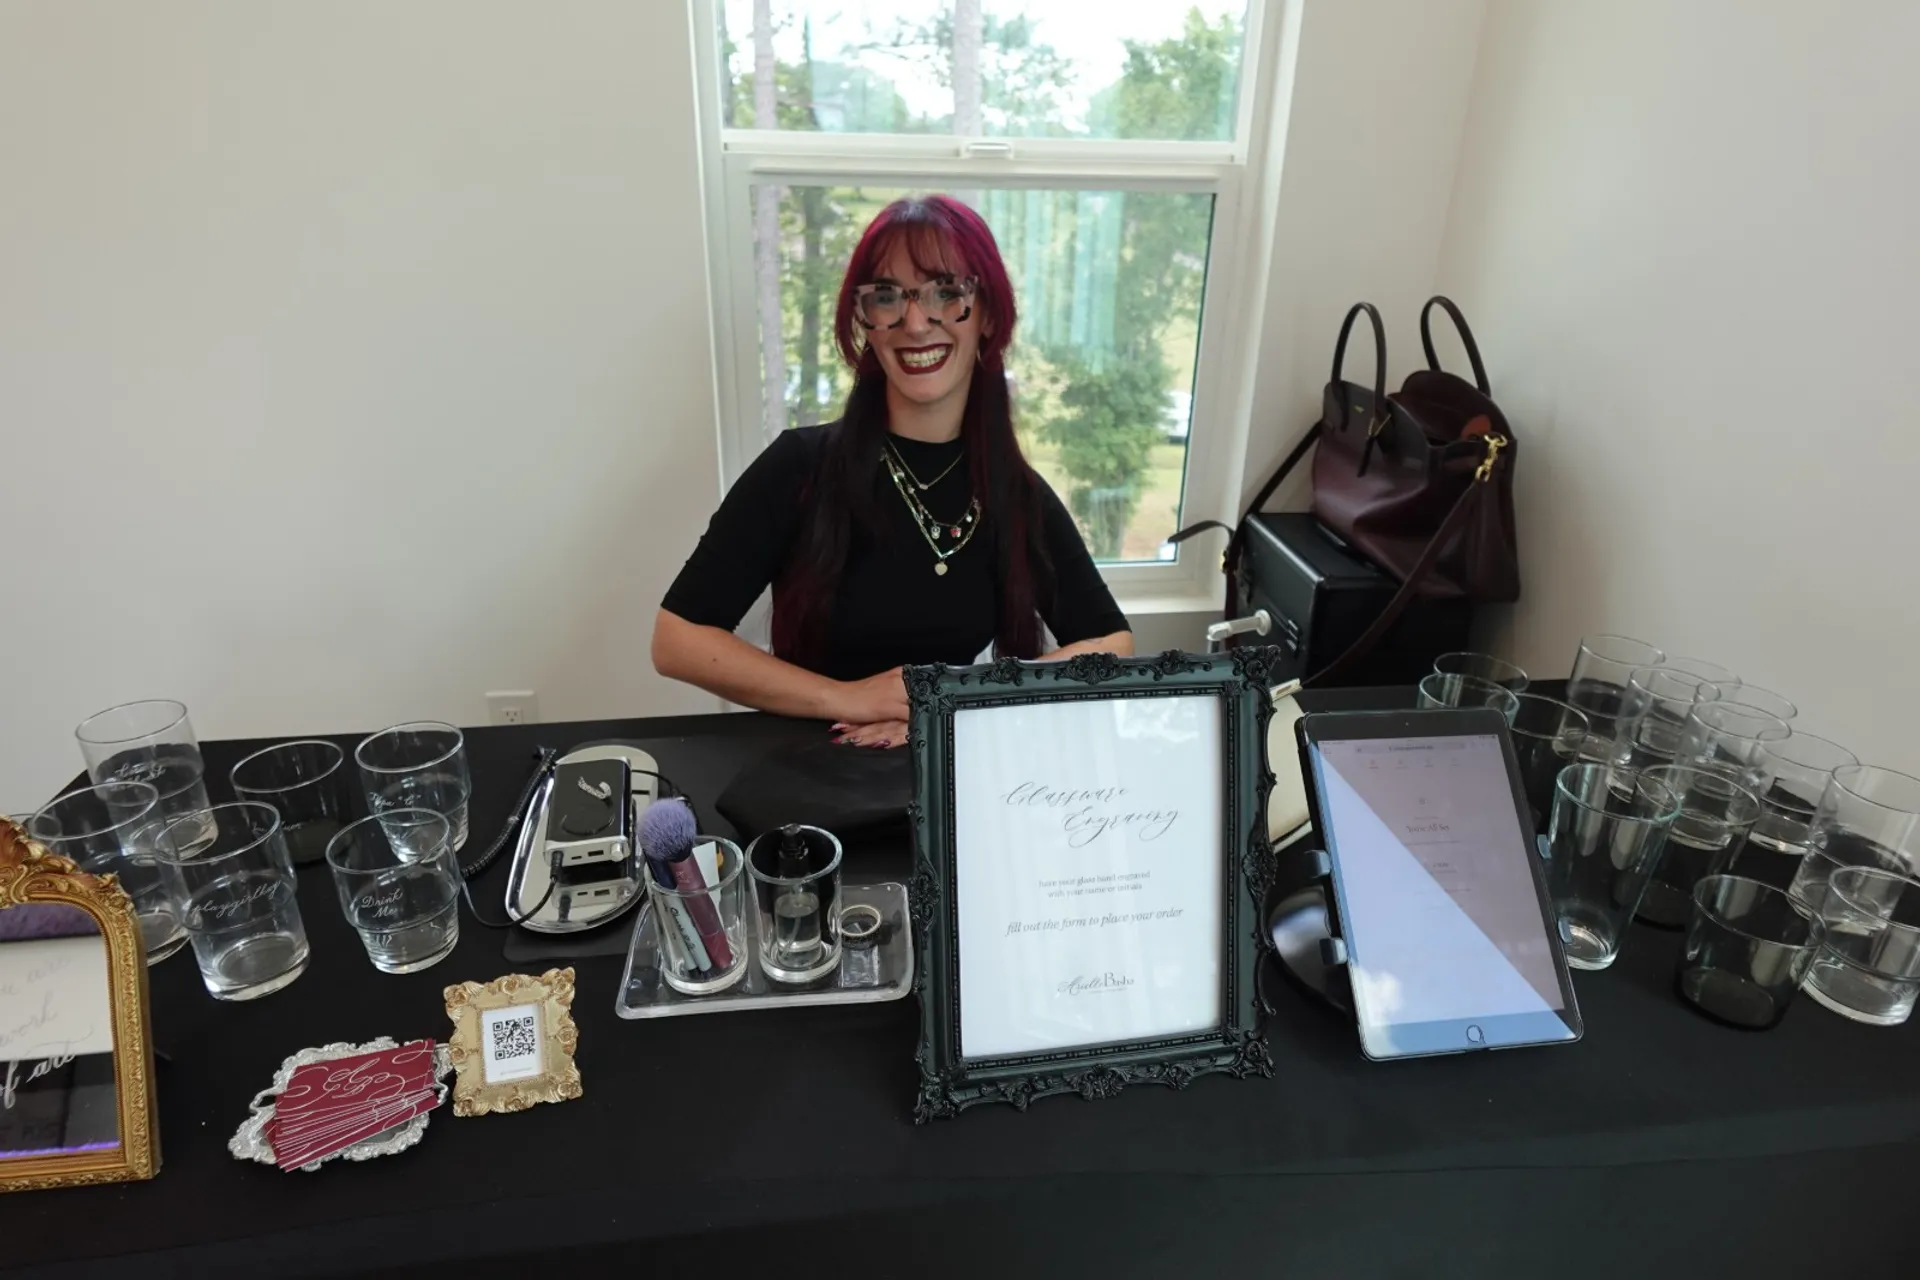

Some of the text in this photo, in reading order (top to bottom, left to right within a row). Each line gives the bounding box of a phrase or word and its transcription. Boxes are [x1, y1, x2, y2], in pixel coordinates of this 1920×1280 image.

[1000, 781, 1128, 807] Glassware
[1061, 806, 1178, 848] Engraving
[361, 888, 403, 908] Drink
[1004, 906, 1183, 937] fill out the form to place your order
